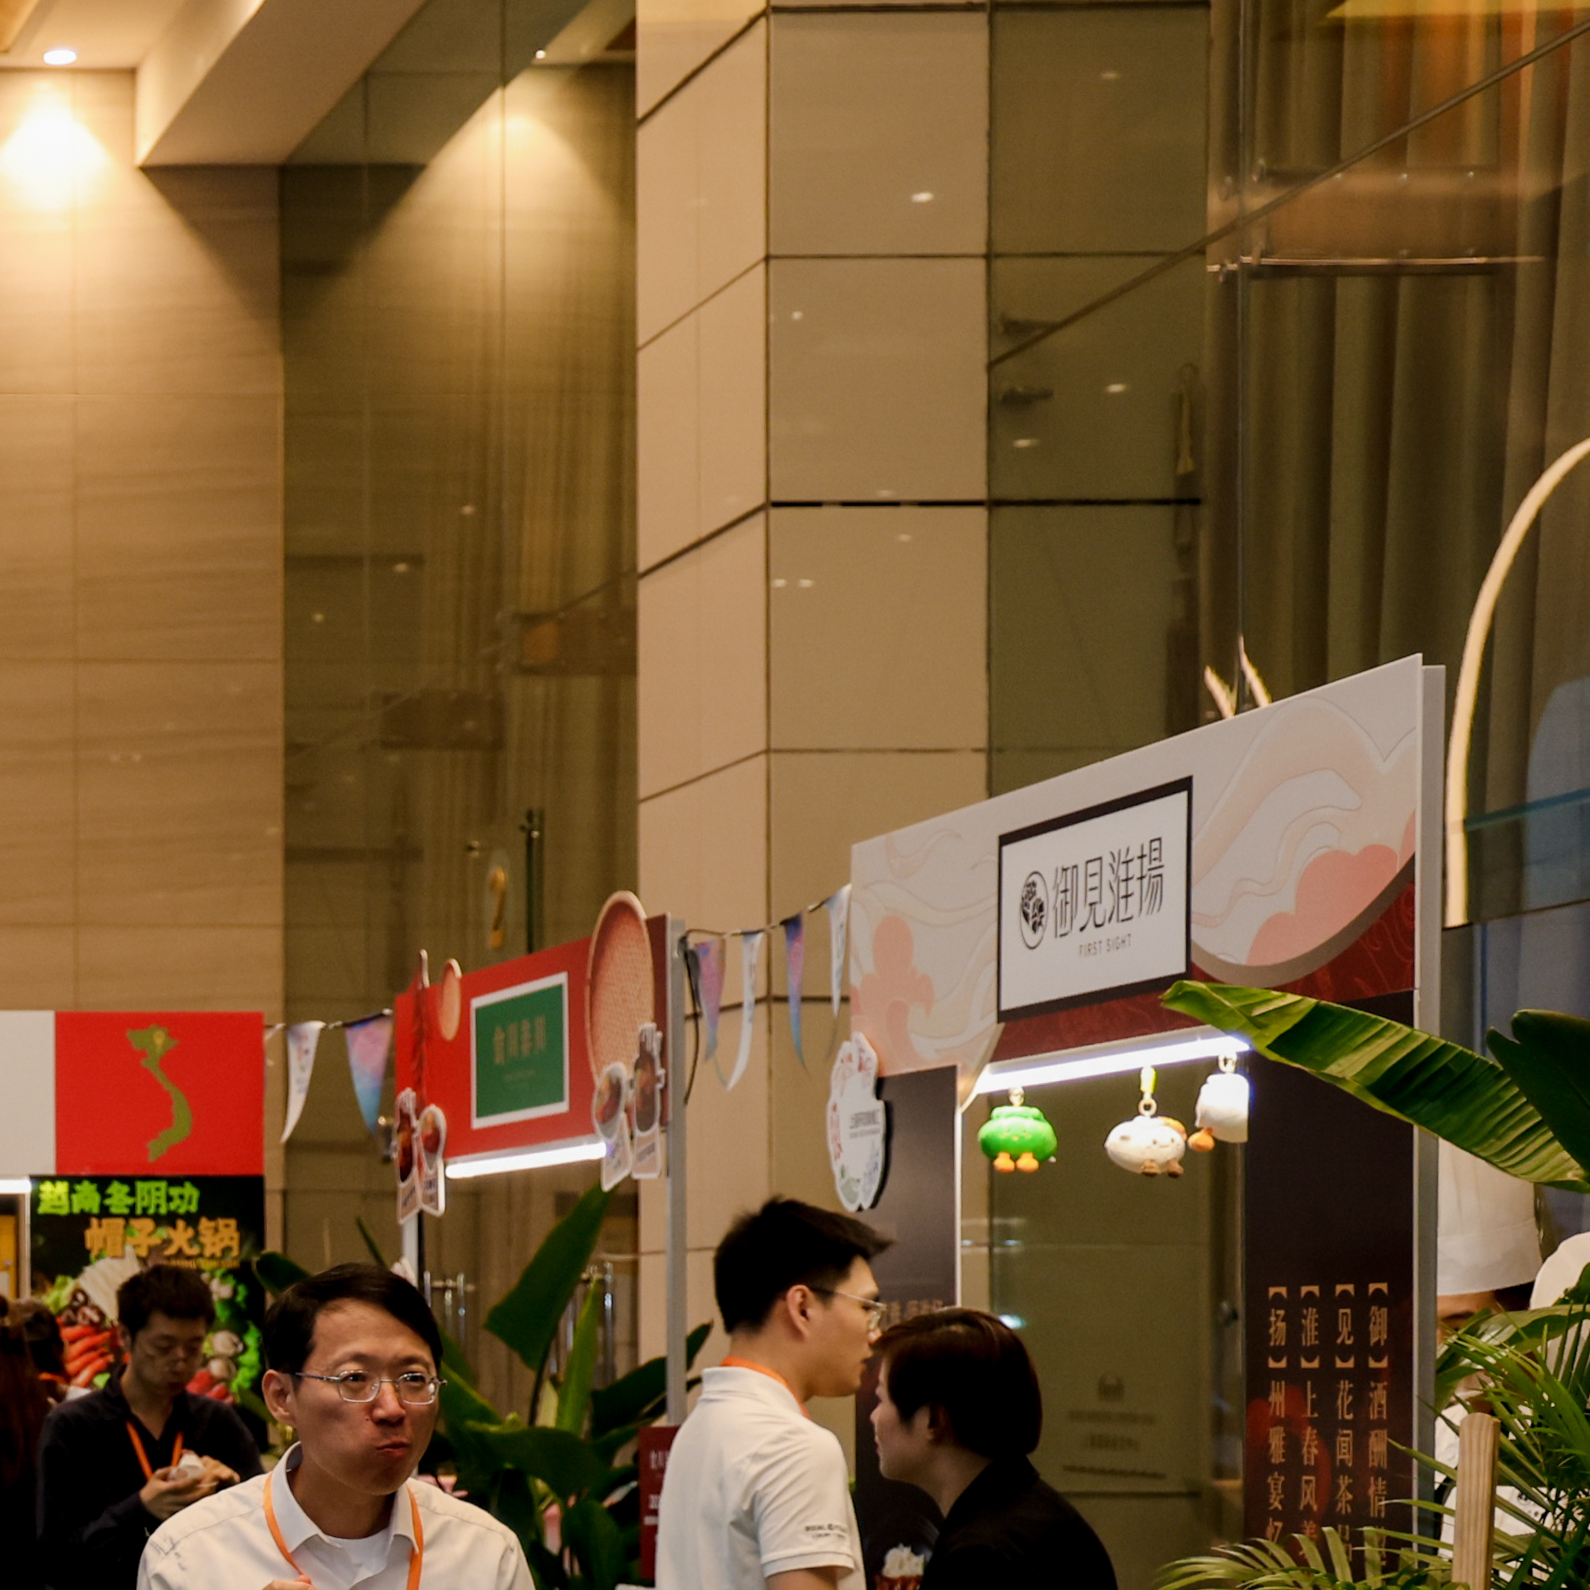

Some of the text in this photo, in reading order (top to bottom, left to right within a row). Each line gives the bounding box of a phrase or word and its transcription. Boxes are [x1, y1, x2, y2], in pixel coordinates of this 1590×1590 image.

[37, 1179, 201, 1216] 越南冬阴功
[84, 1216, 241, 1258] 帽子火锅
